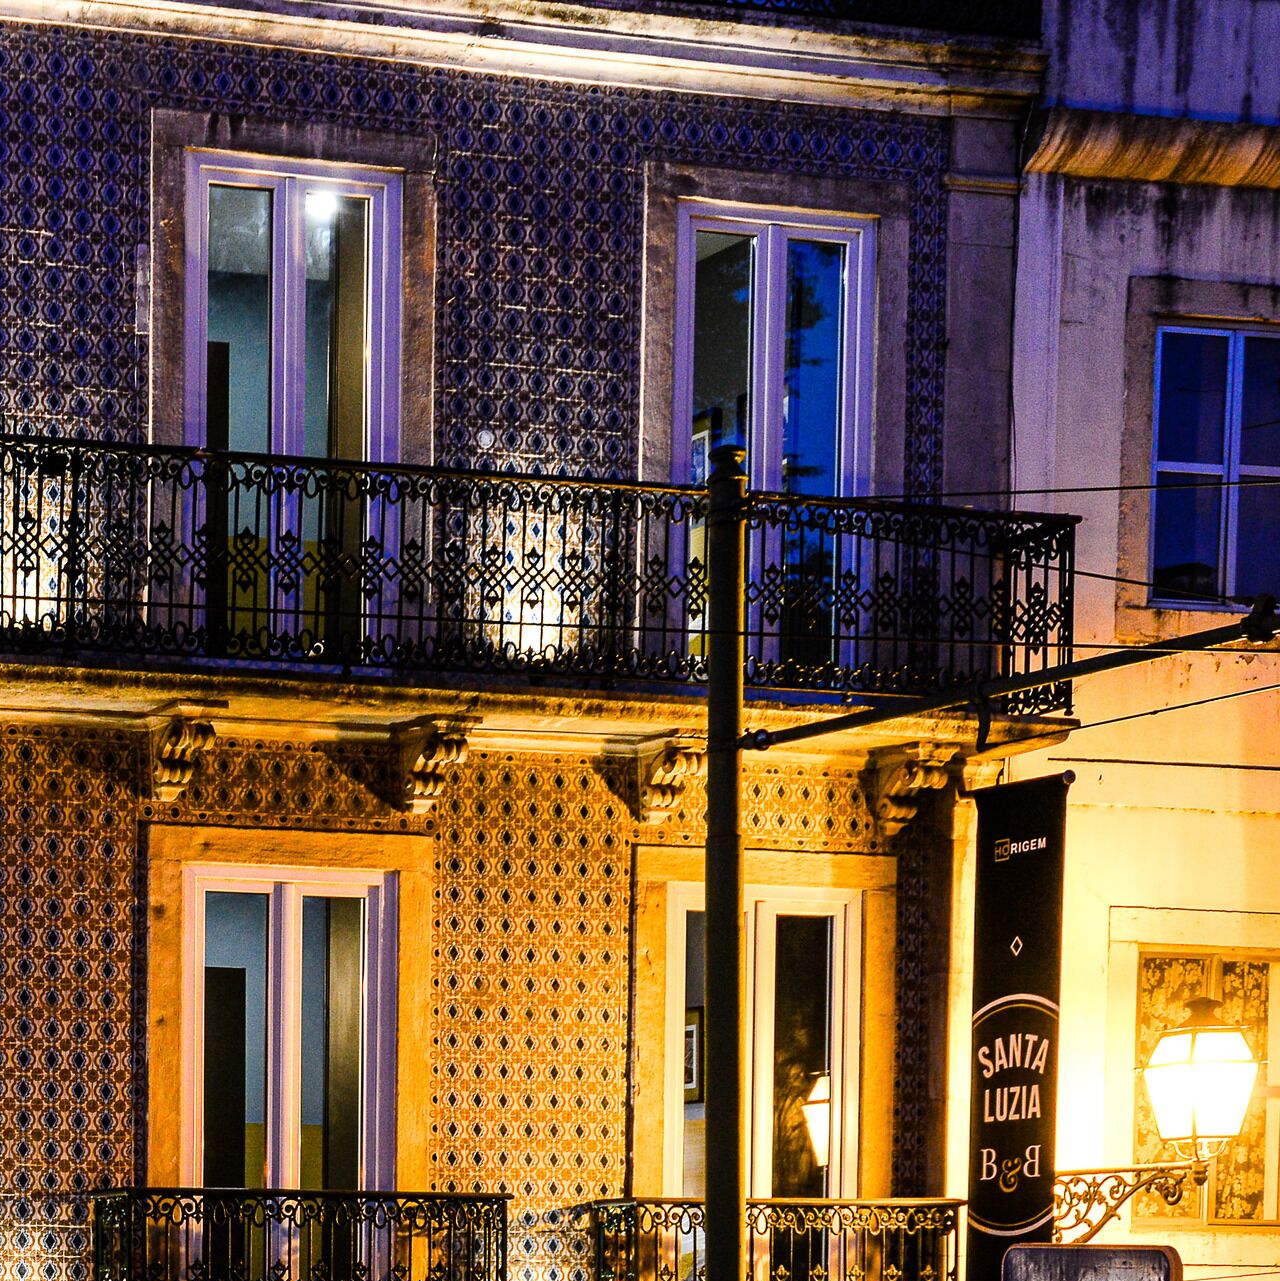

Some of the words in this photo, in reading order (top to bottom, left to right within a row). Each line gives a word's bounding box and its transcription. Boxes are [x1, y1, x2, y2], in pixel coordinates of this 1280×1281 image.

[995, 837, 1046, 861] HORIGEM
[978, 1033, 1049, 1078] SANTA
[984, 1085, 1041, 1123] LUZIA
[980, 1144, 1042, 1193] B&B
